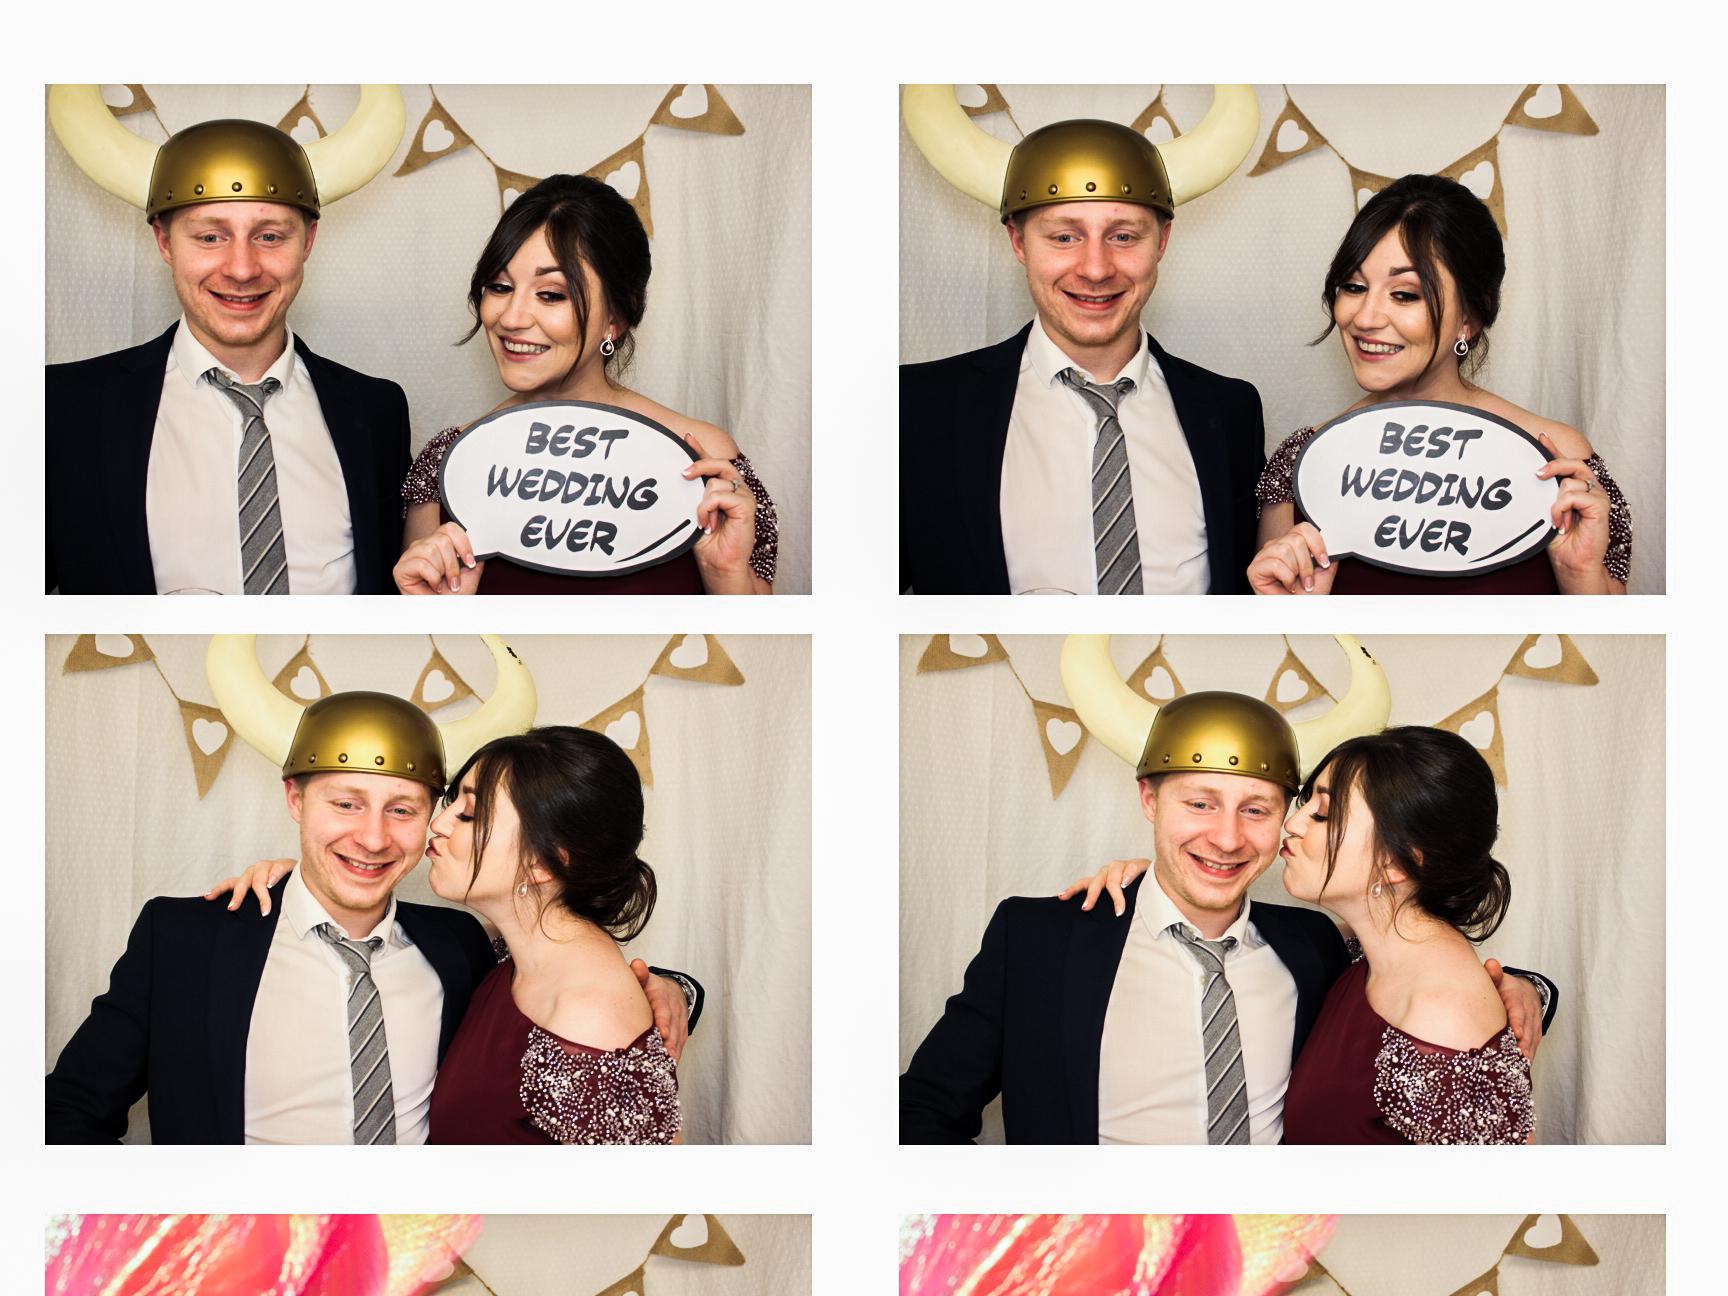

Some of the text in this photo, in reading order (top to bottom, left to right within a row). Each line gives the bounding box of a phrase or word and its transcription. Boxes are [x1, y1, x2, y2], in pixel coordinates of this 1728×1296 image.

[525, 421, 630, 460] BEST
[1379, 421, 1484, 460] BEST
[487, 464, 659, 511] WEDDING
[1341, 464, 1513, 511] WEDDING
[520, 515, 618, 557] EVER
[1374, 515, 1472, 557] EVER
